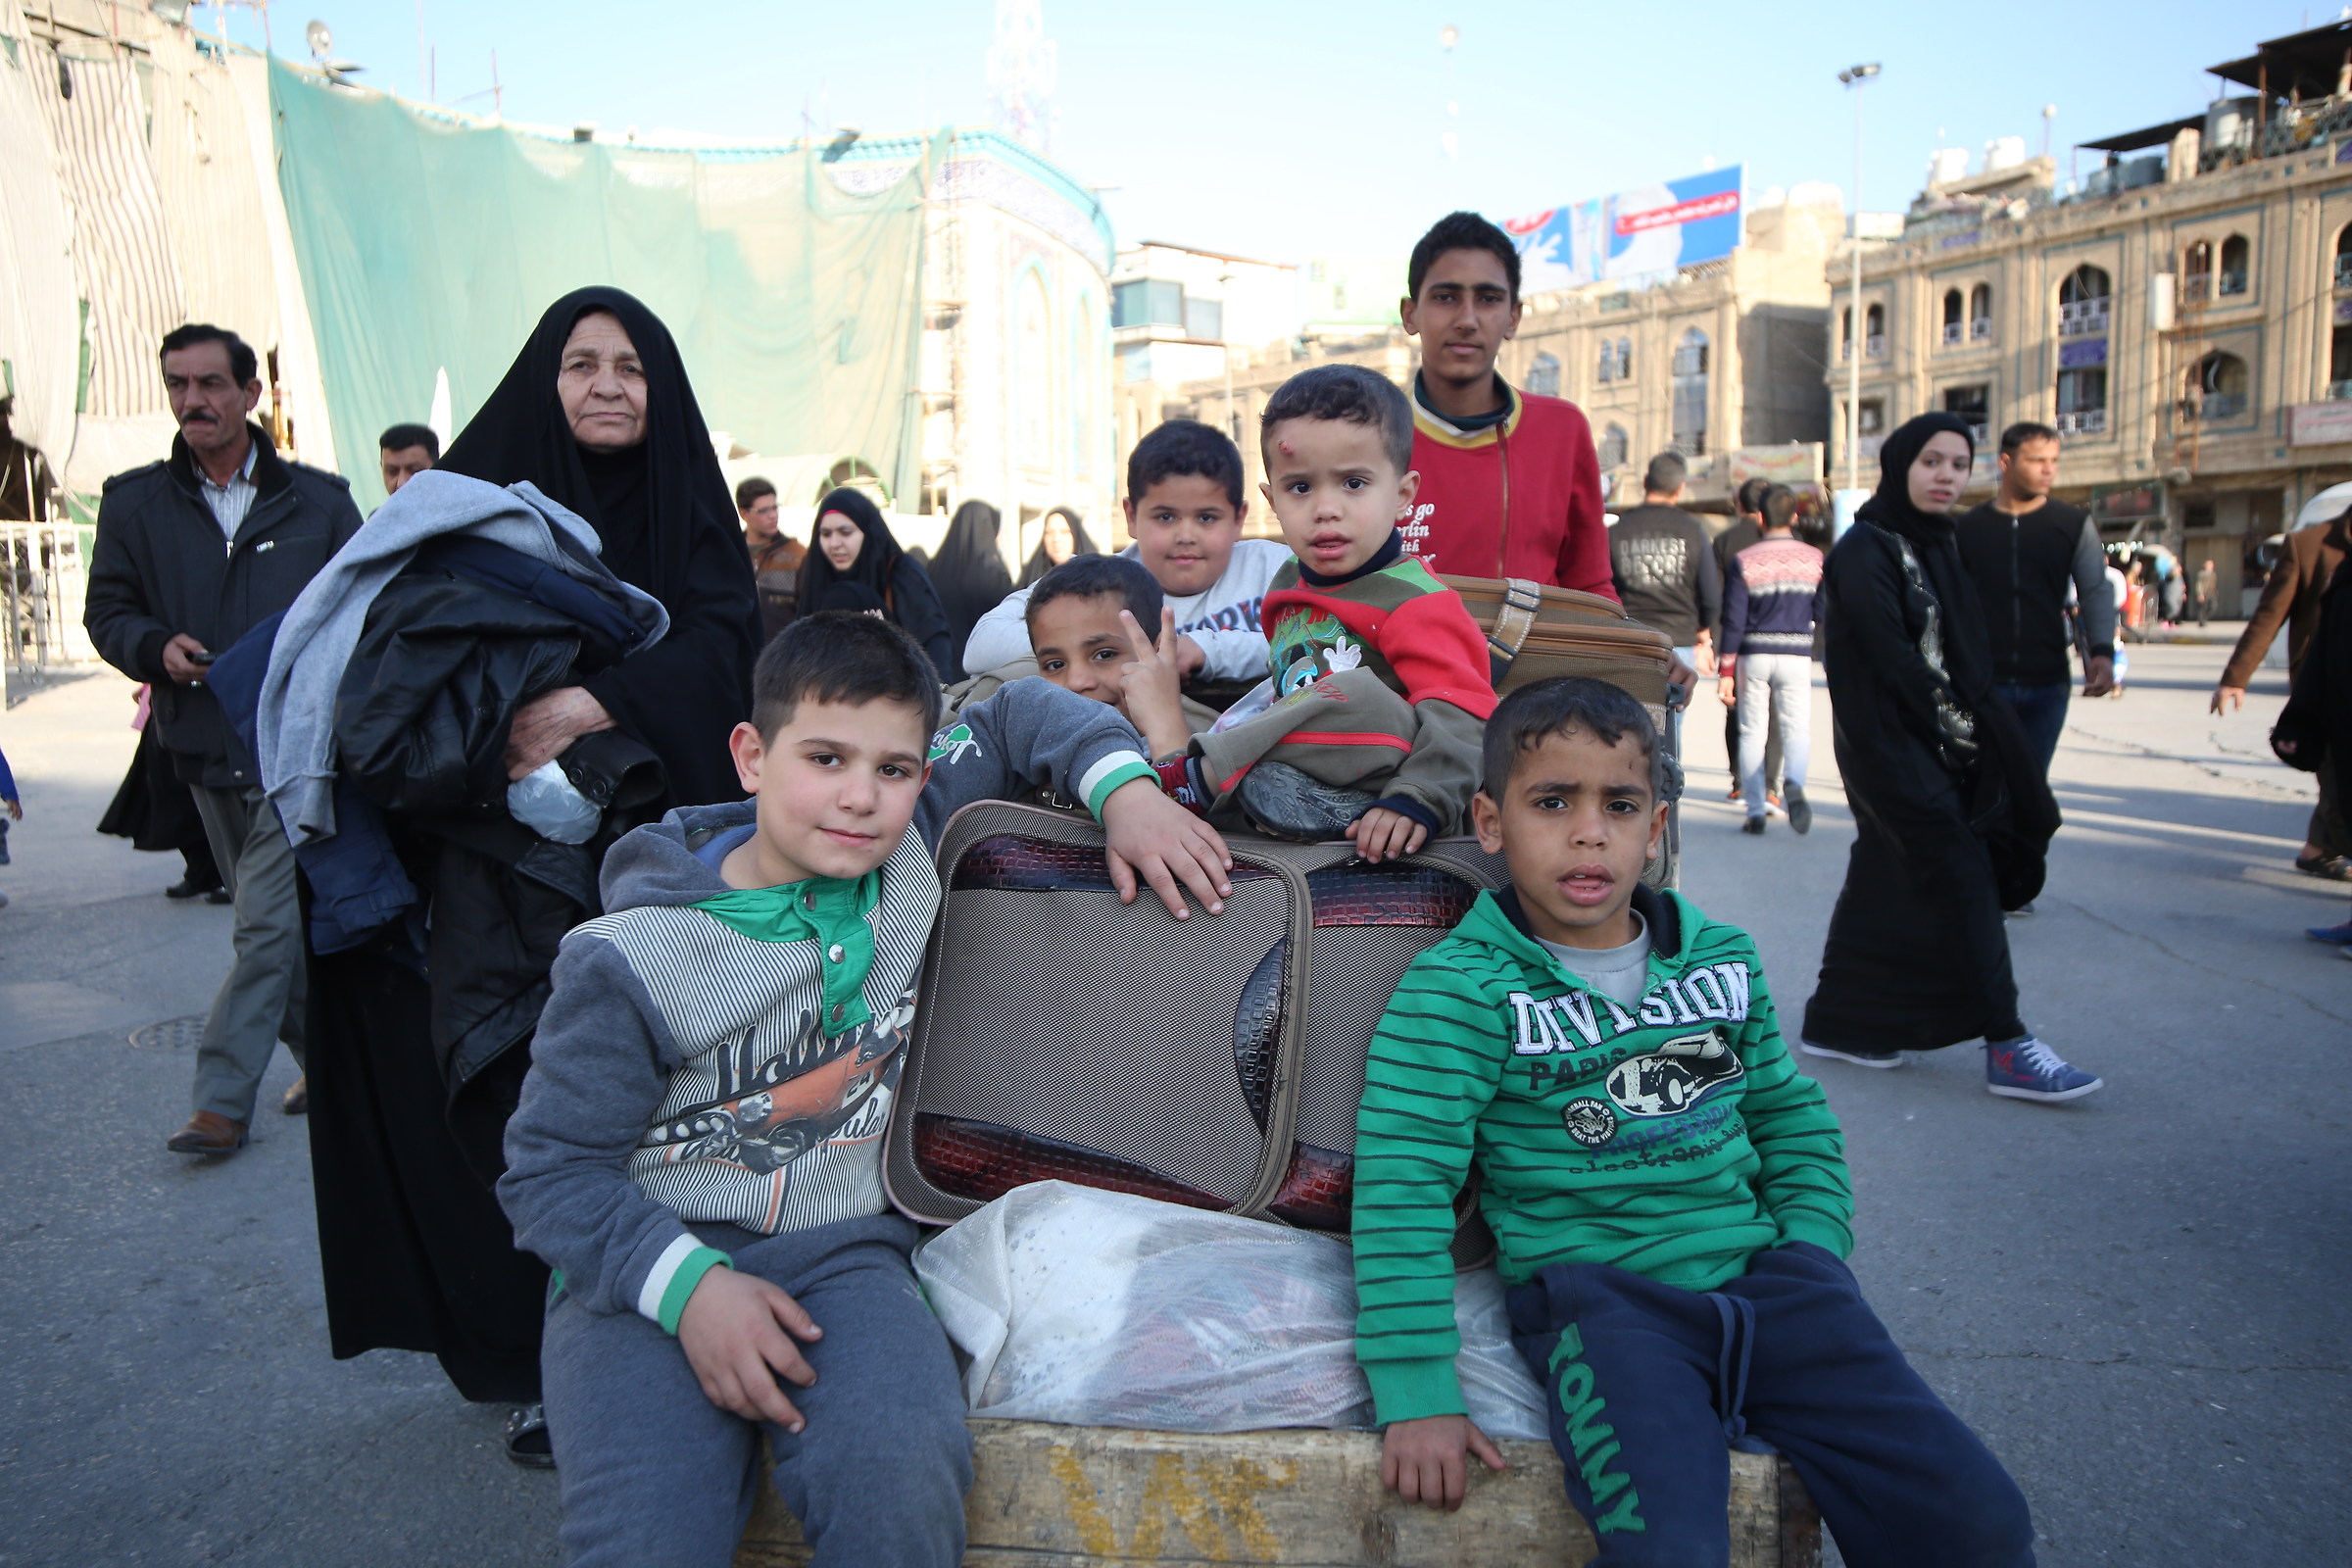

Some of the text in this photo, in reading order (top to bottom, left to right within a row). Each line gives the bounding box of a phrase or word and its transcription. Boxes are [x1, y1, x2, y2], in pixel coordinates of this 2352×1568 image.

[1414, 503, 1436, 520] go
[1400, 538, 1420, 552] ith
[1507, 961, 1751, 1055] DIVISION
[1529, 1048, 1627, 1091] PARIS
[1571, 1127, 1587, 1142] BEAT
[1588, 1135, 1600, 1144] THE
[1548, 1322, 1646, 1534] TOMMY
